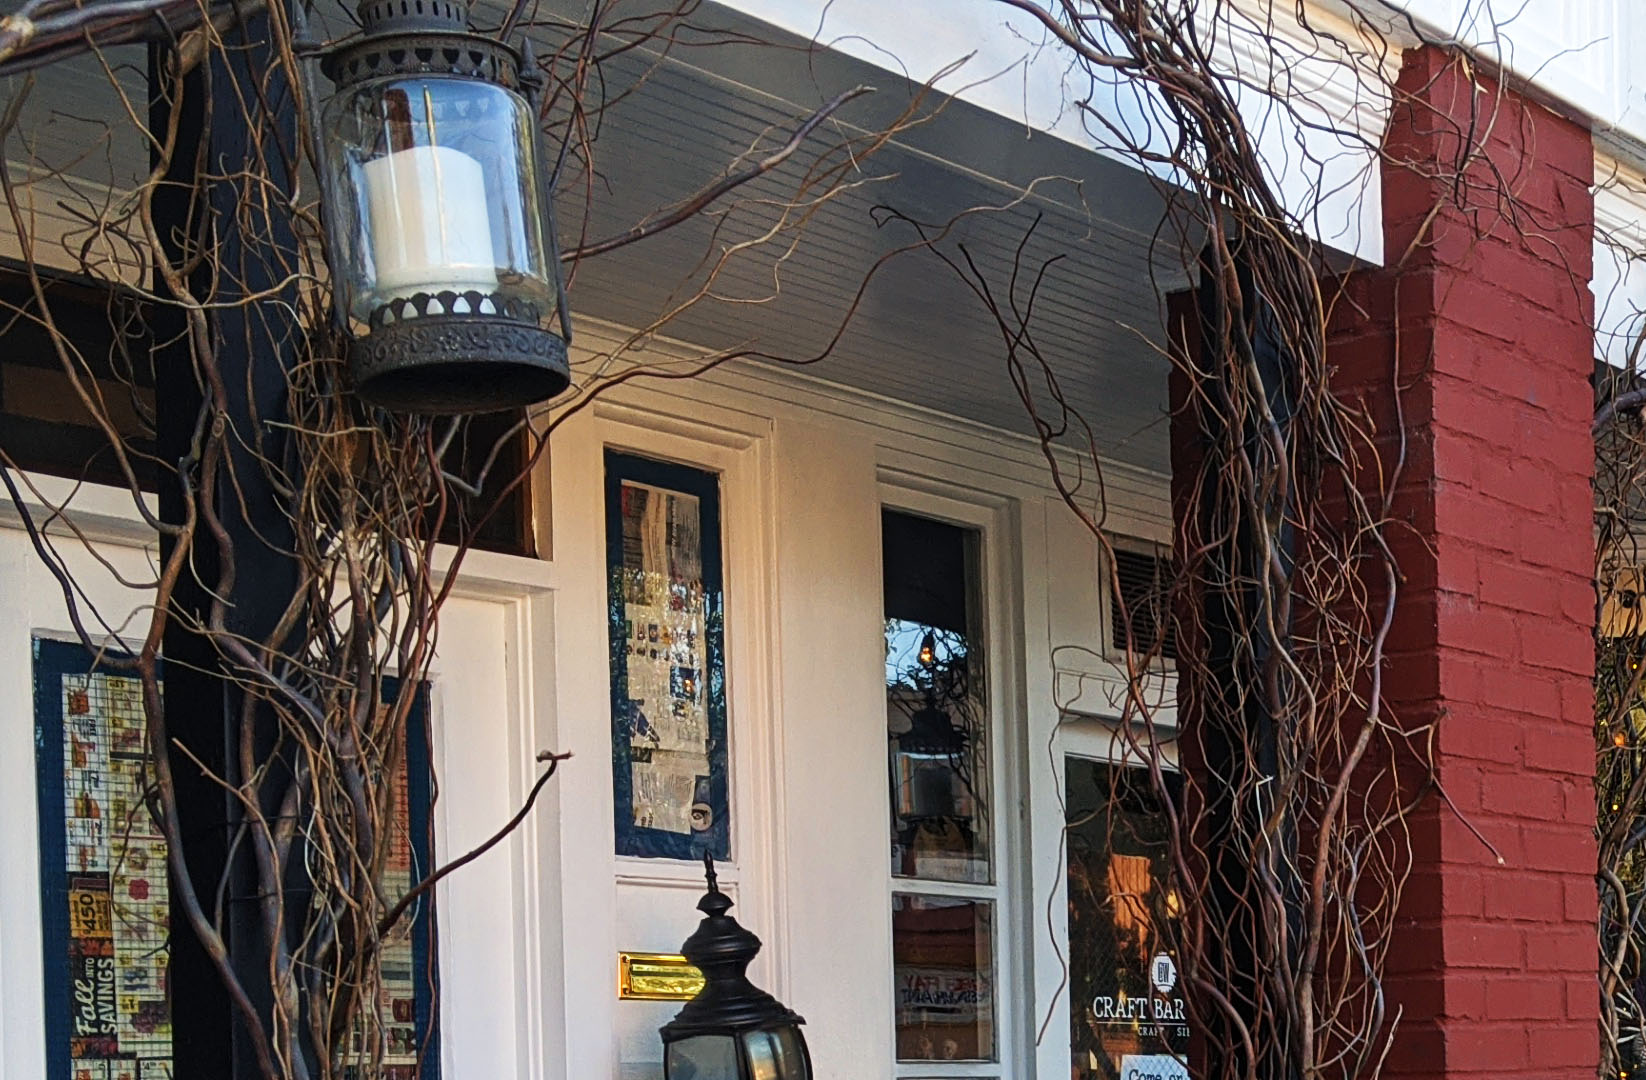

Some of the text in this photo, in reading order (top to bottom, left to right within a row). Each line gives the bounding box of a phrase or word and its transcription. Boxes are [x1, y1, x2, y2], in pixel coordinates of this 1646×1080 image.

[74, 979, 99, 1037] Fall
[96, 957, 118, 1034] SAVINGS
[1093, 996, 1186, 1020] CRAFT BAR
[1138, 1026, 1165, 1036] CRAFT
